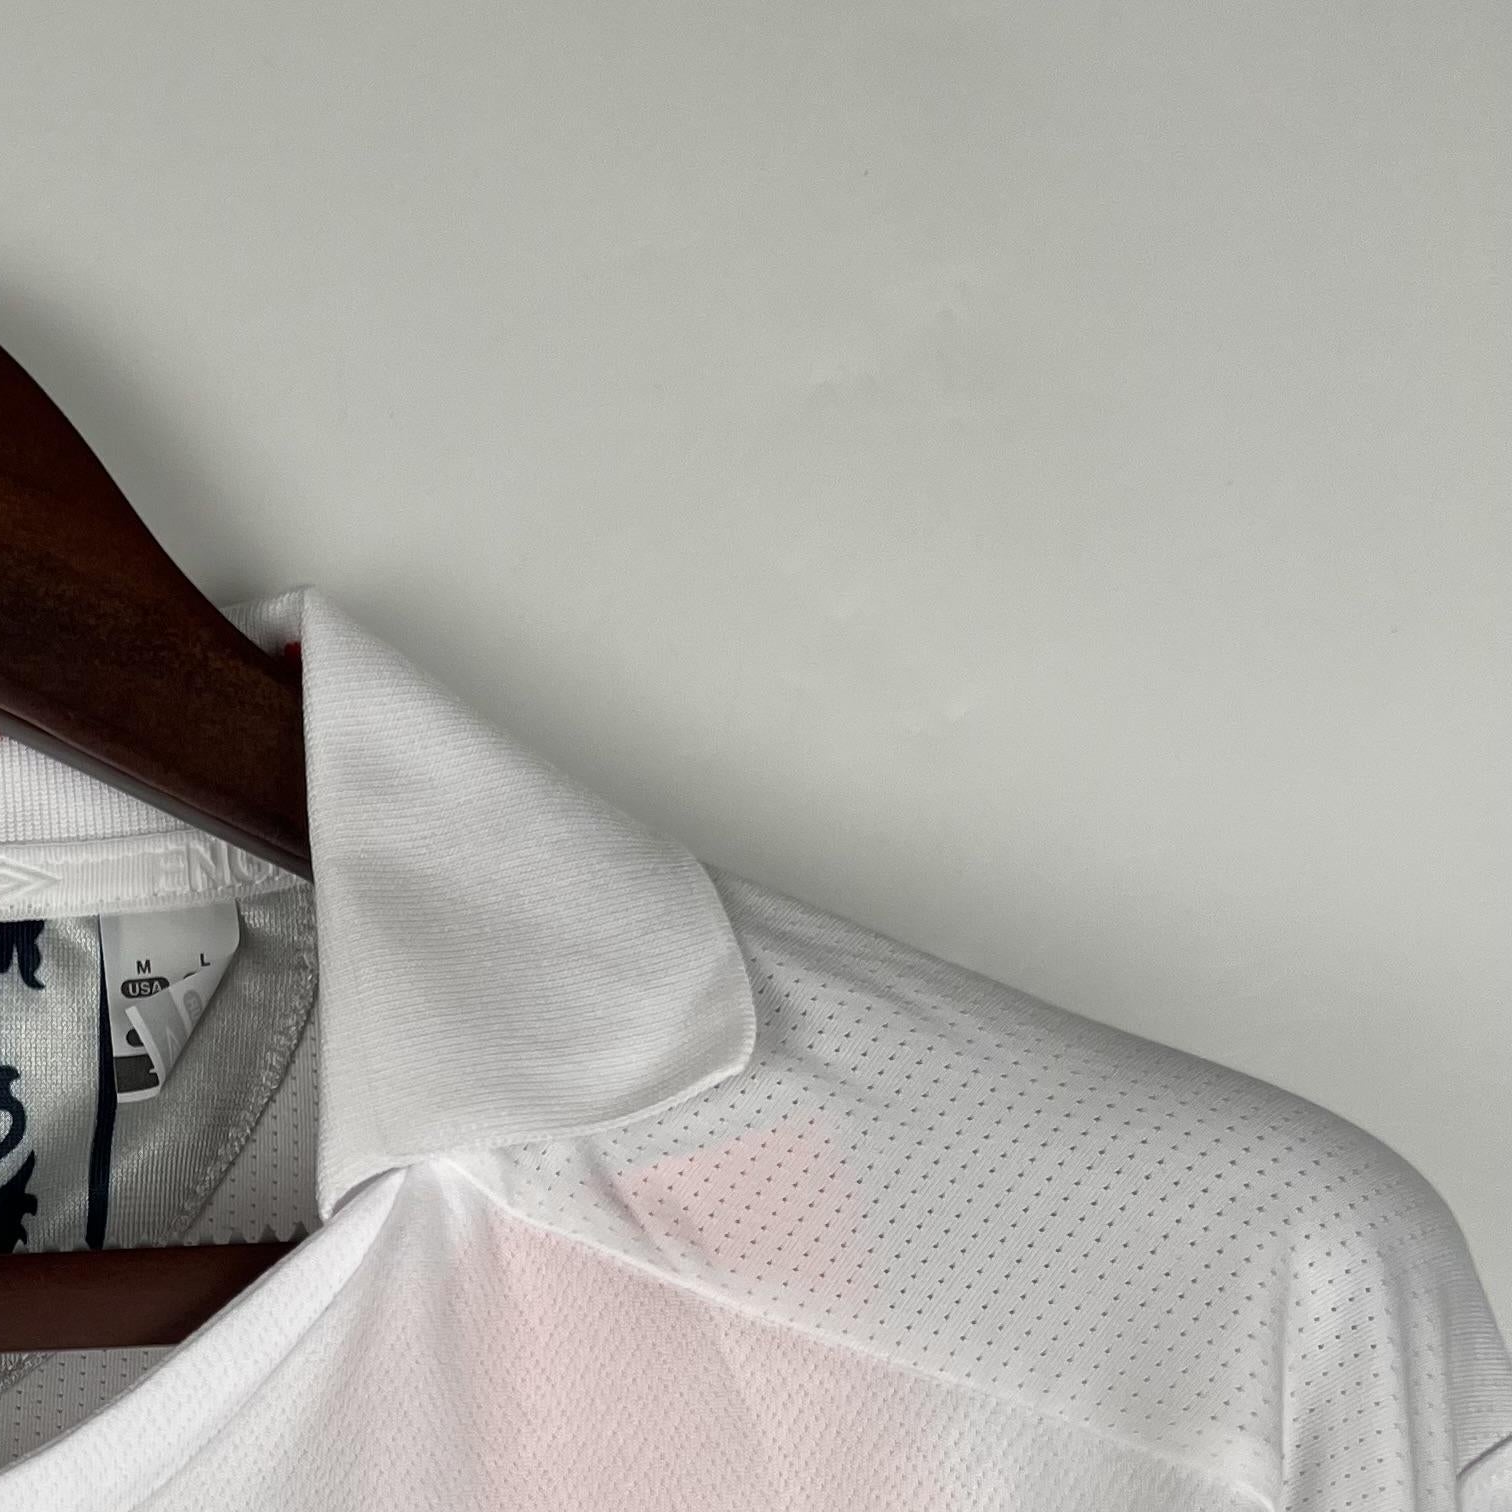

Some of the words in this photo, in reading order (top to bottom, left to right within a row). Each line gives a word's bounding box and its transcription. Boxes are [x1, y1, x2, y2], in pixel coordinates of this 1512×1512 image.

[136, 959, 152, 975] M
[199, 952, 212, 968] L
[128, 980, 165, 997] USA
